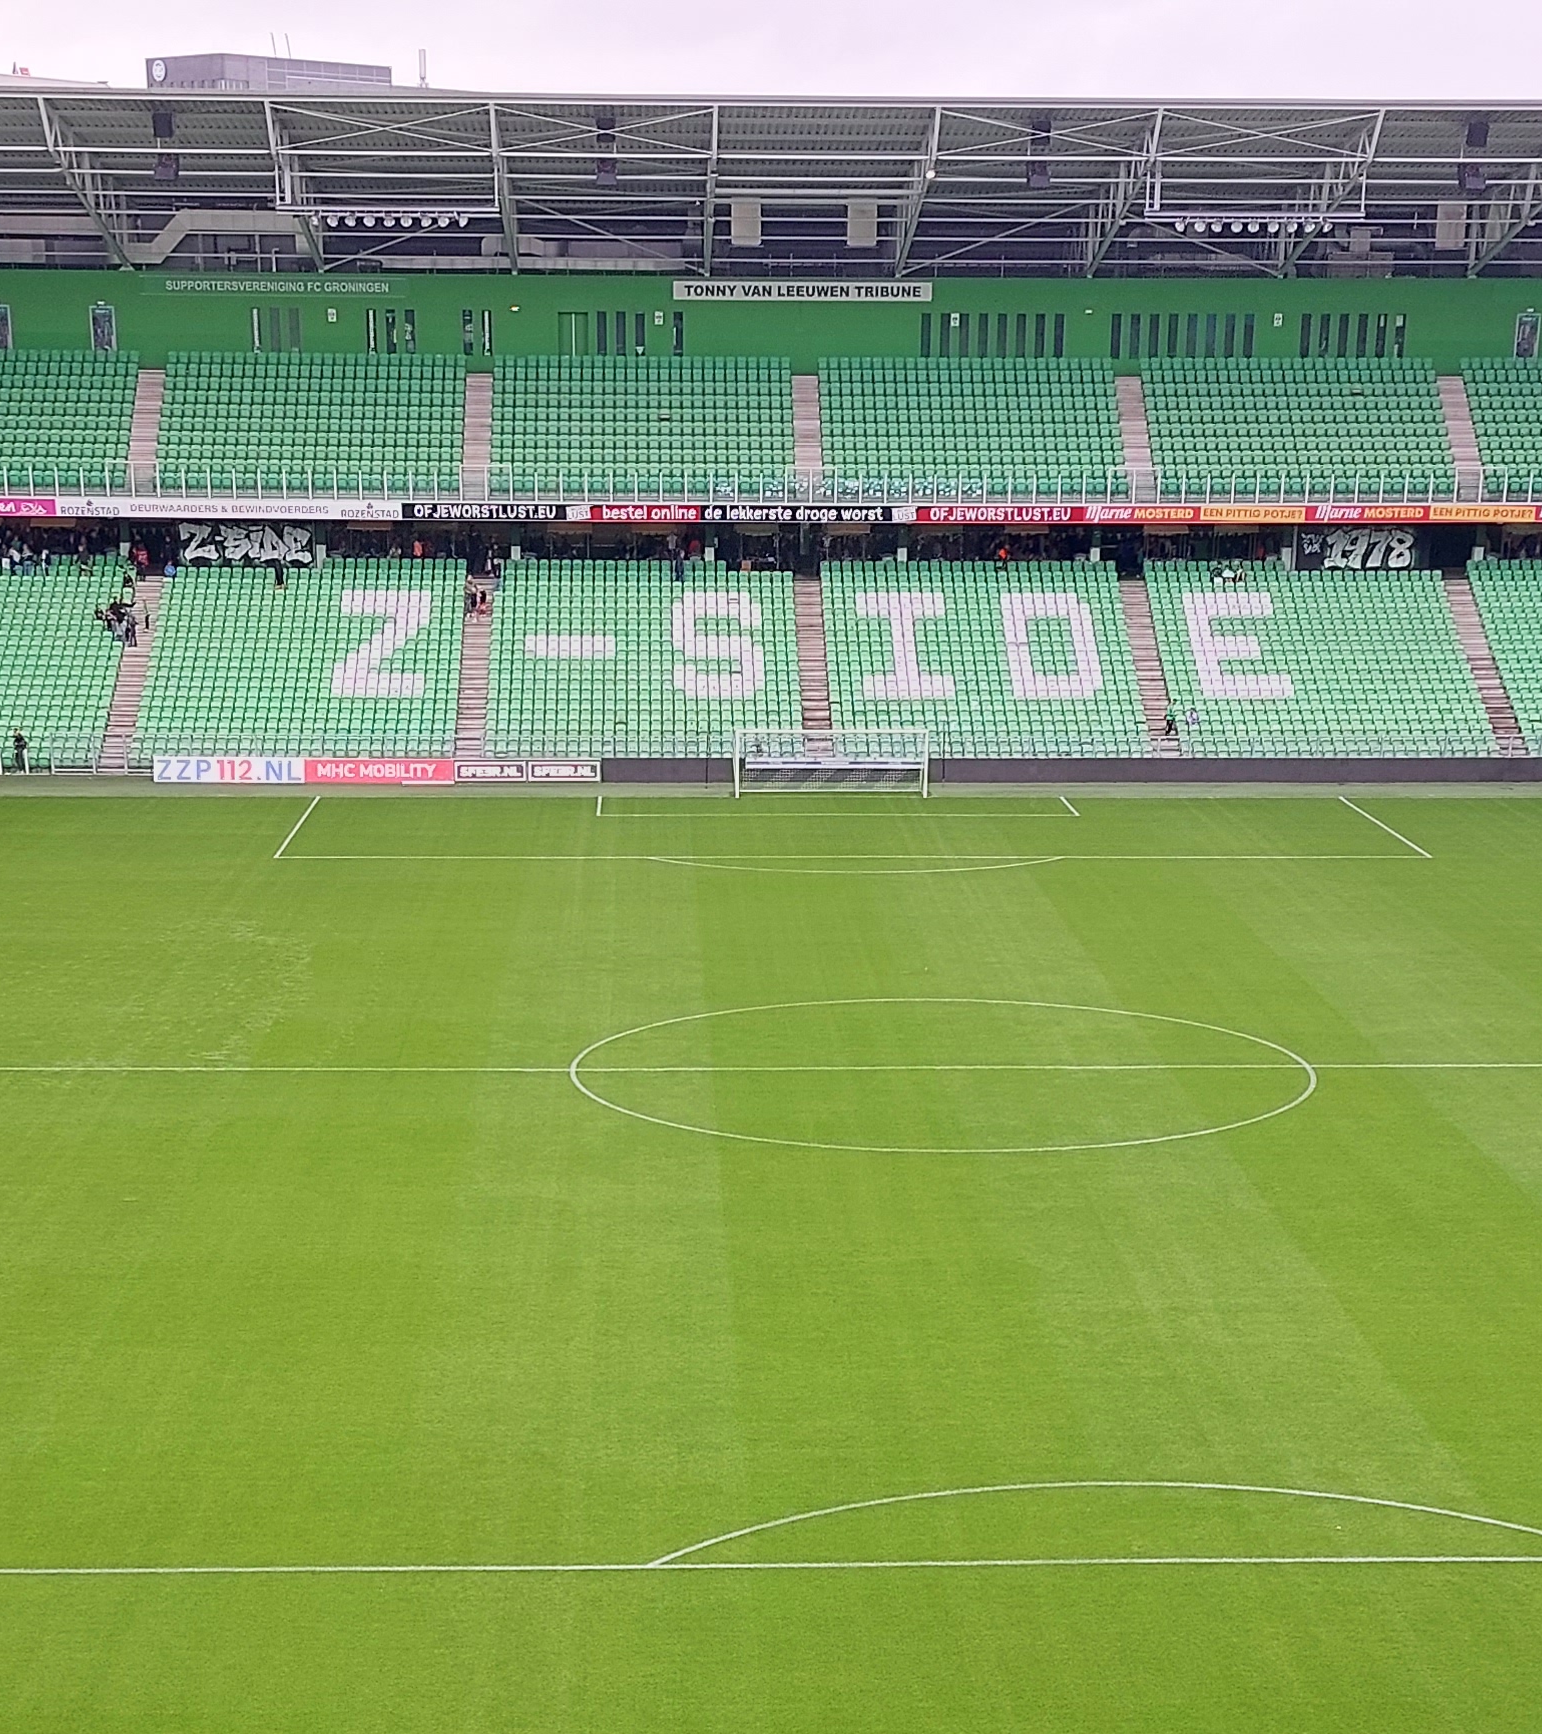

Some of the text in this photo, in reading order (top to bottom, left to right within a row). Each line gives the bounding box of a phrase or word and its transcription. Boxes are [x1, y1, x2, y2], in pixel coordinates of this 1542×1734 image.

[165, 280, 389, 293] SUPPORTERSVERENIGING FC GRONINGEN
[684, 285, 922, 297] TONNY VAN LEEUWEN TRIBUNE
[60, 505, 120, 516] ROZENSTAD
[129, 503, 329, 515] DEURWAARDERS & BEWINDVOERDERS
[340, 508, 399, 519] ROZENSTAD
[414, 505, 556, 519] OFJEWORSTLUST.EU
[602, 504, 883, 522] bestel online de lekkerste droge worst
[930, 507, 1071, 521] OFJEWORSTLUST.EU
[1133, 508, 1194, 519] MOSTERD
[1203, 508, 1303, 519] EEN PITTIG POTJE?
[1363, 507, 1424, 518] MOSTERD
[1433, 507, 1533, 519] EEN PITTIG POTJE?
[1324, 527, 1415, 569] 1978
[328, 588, 1296, 701] Z-SIDE
[157, 759, 302, 781] ZZP112.NL
[317, 763, 437, 779] MHC MOBILITY
